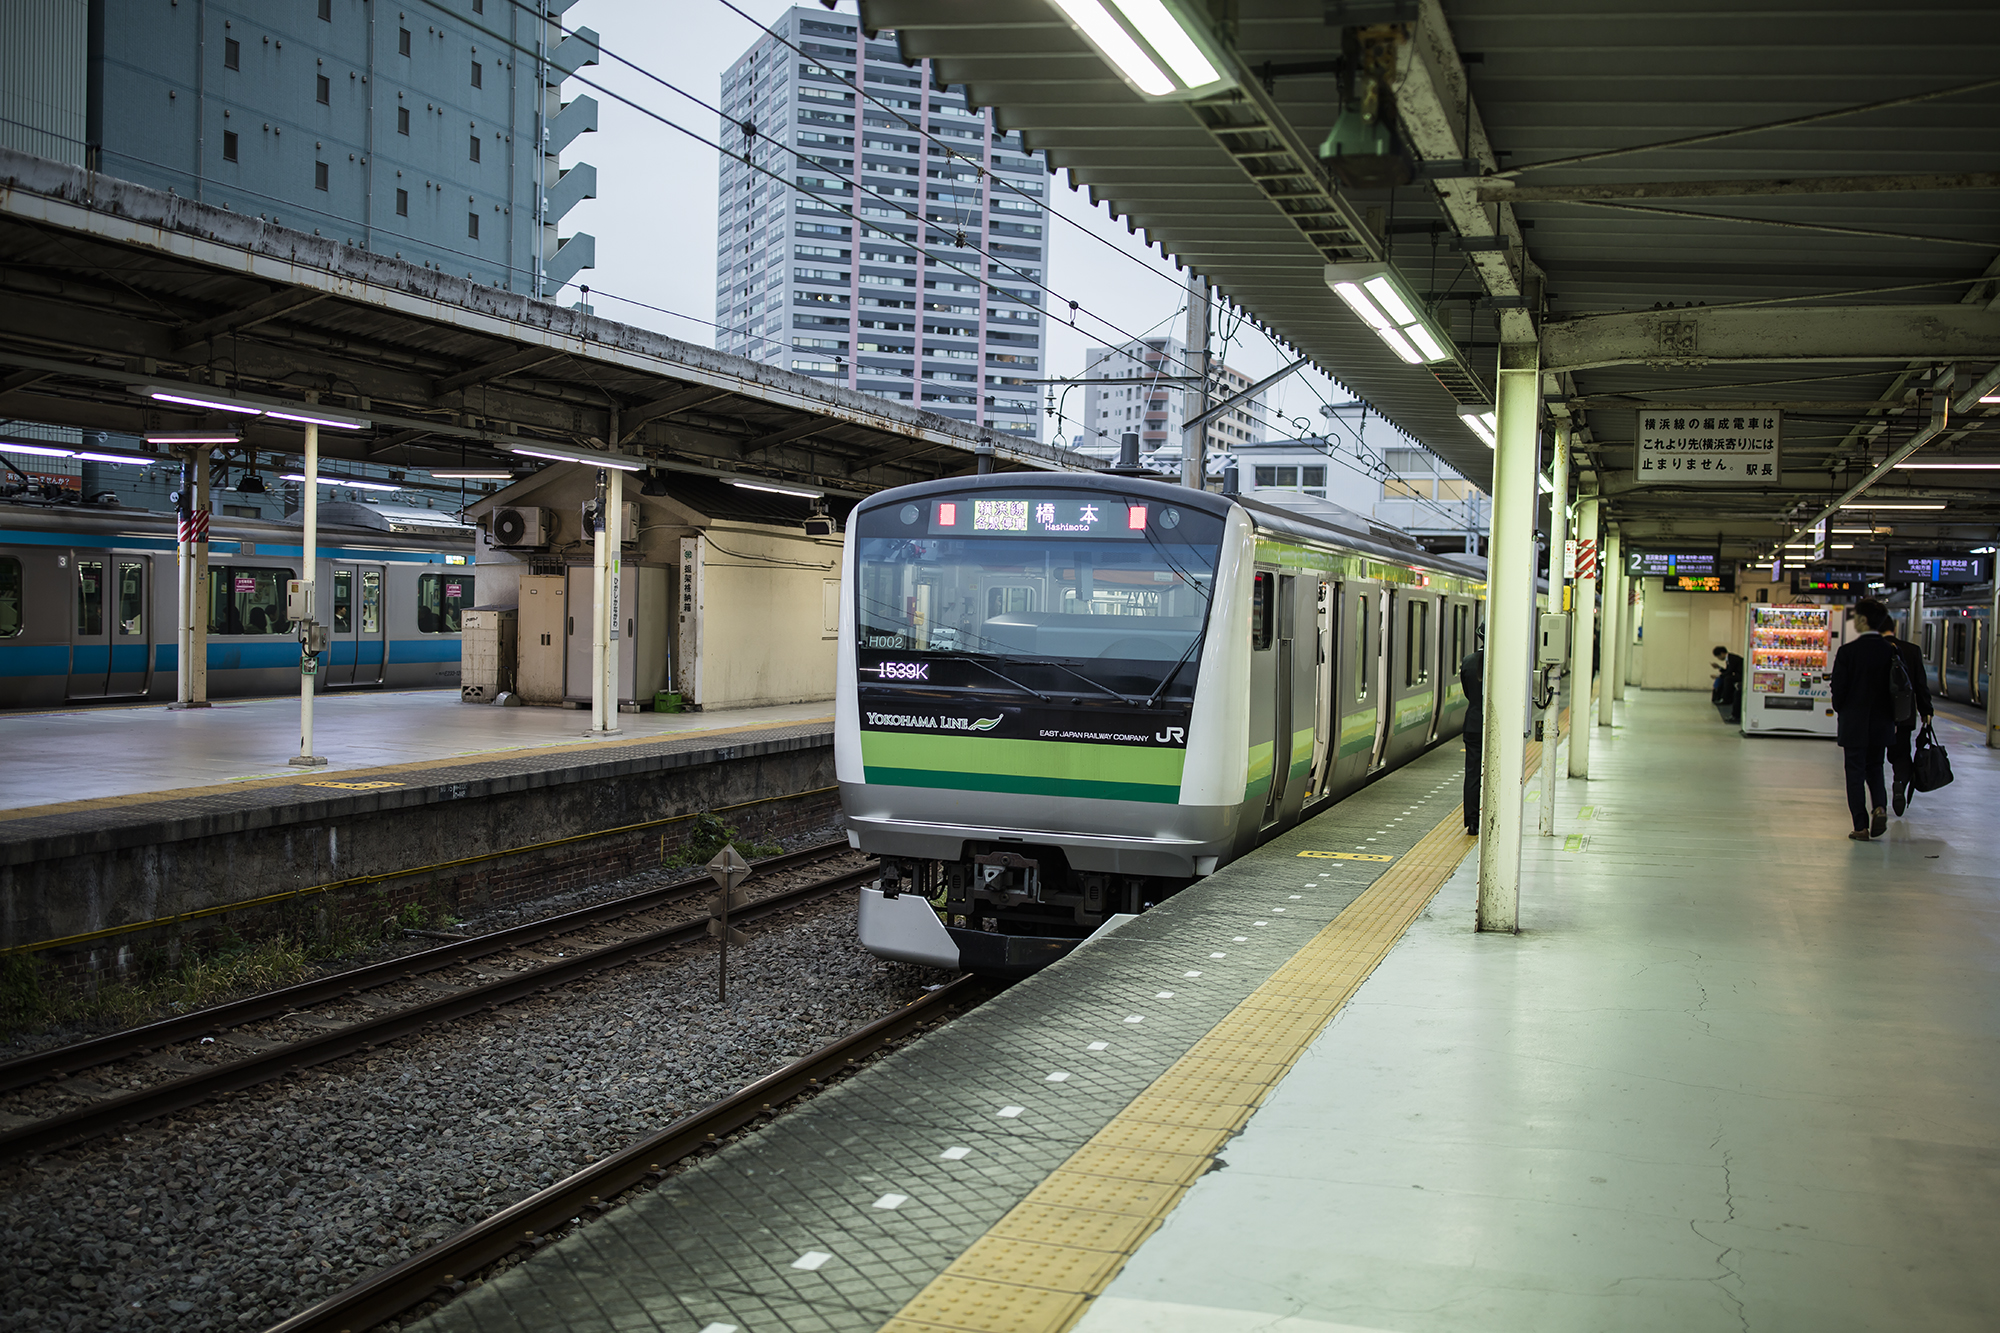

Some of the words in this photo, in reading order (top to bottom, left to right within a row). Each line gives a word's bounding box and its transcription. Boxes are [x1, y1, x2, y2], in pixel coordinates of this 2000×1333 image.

[1644, 417, 1774, 430] 横浜線の編成電車は
[1643, 438, 1774, 450] これより先(横浜寄り)には
[1641, 457, 1734, 471] 止まりません。
[1746, 463, 1773, 476] 駅長
[978, 501, 1025, 516] 横浜線
[1035, 503, 1099, 524] 橋本
[1044, 523, 1090, 531] Hashimoto
[60, 557, 66, 566] 3
[1630, 554, 1642, 569] 2
[1971, 560, 1979, 576] 1
[868, 635, 903, 648] H002
[879, 661, 929, 680] 1539K
[1798, 688, 1828, 697] acure
[866, 711, 938, 728] YOKOHAMA
[940, 716, 969, 730] LINE
[1039, 729, 1059, 737] EAST
[1059, 730, 1083, 739] JAPAN
[1083, 731, 1113, 740] RAILWAY
[1113, 733, 1149, 742] COMPANY
[1155, 726, 1185, 744] JR
